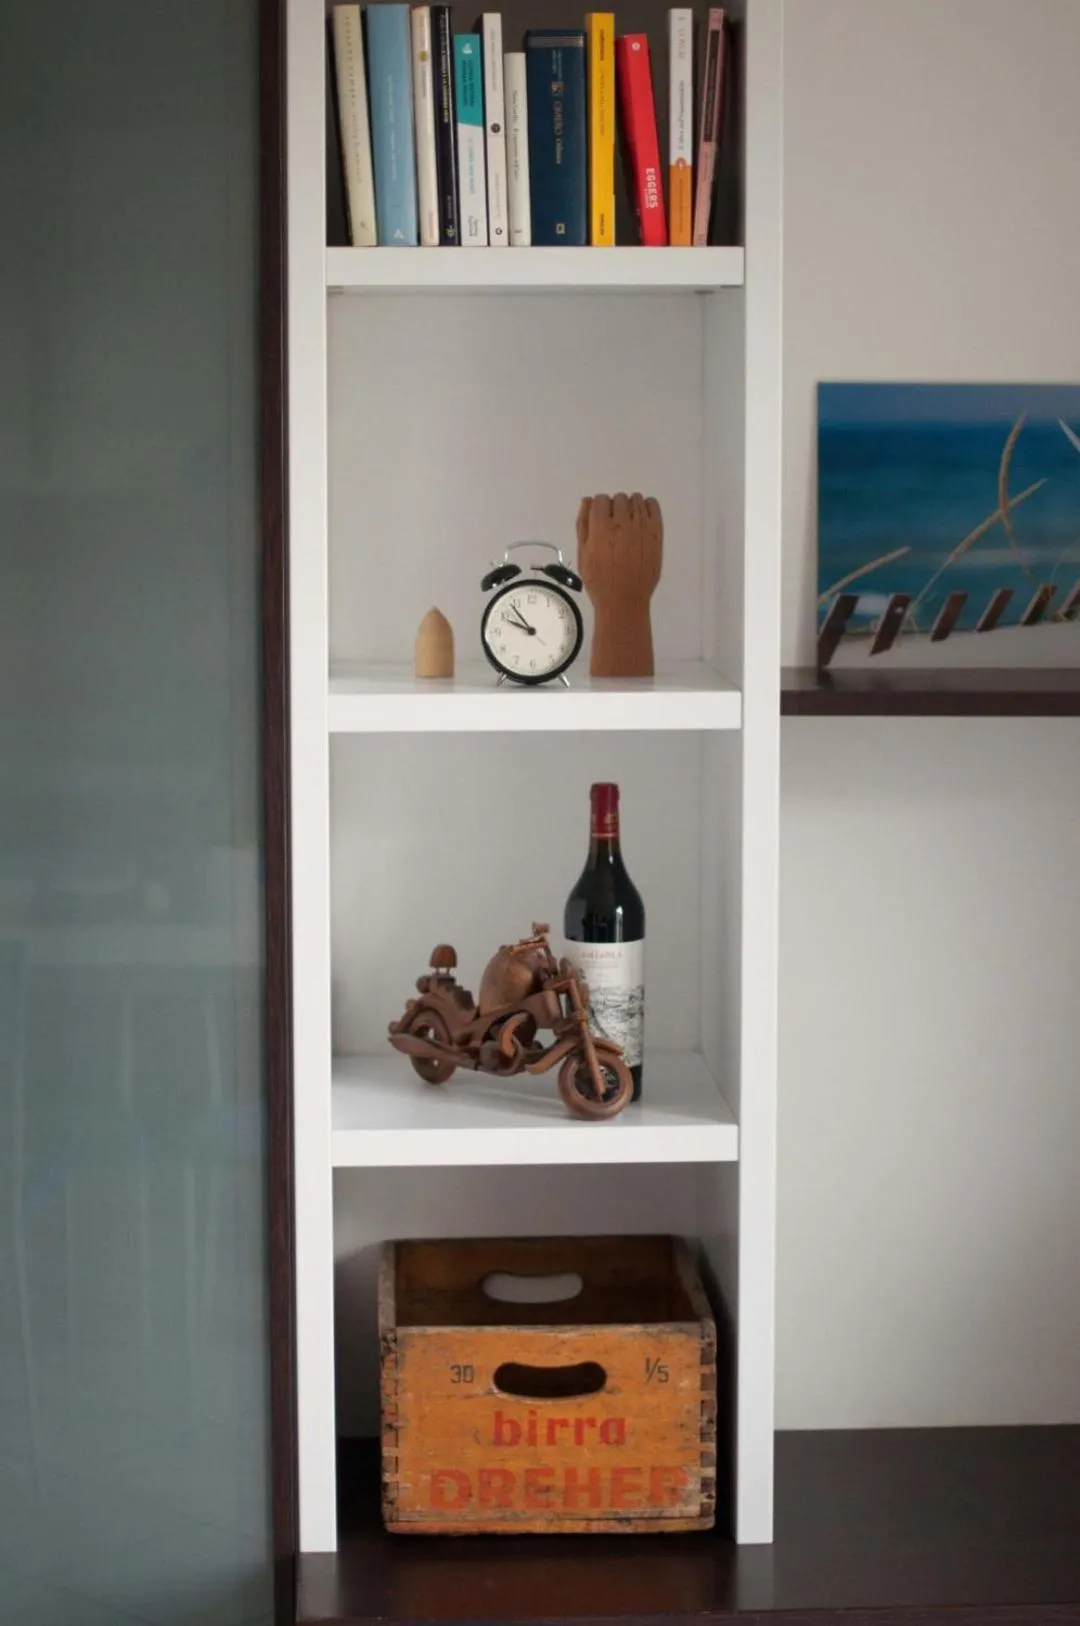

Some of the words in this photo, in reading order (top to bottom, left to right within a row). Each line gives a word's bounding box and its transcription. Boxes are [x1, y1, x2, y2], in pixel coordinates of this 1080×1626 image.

[645, 167, 658, 209] EGGERS
[450, 1364, 475, 1384] 30
[493, 1409, 628, 1448] birra
[429, 1466, 690, 1510] DREHER
